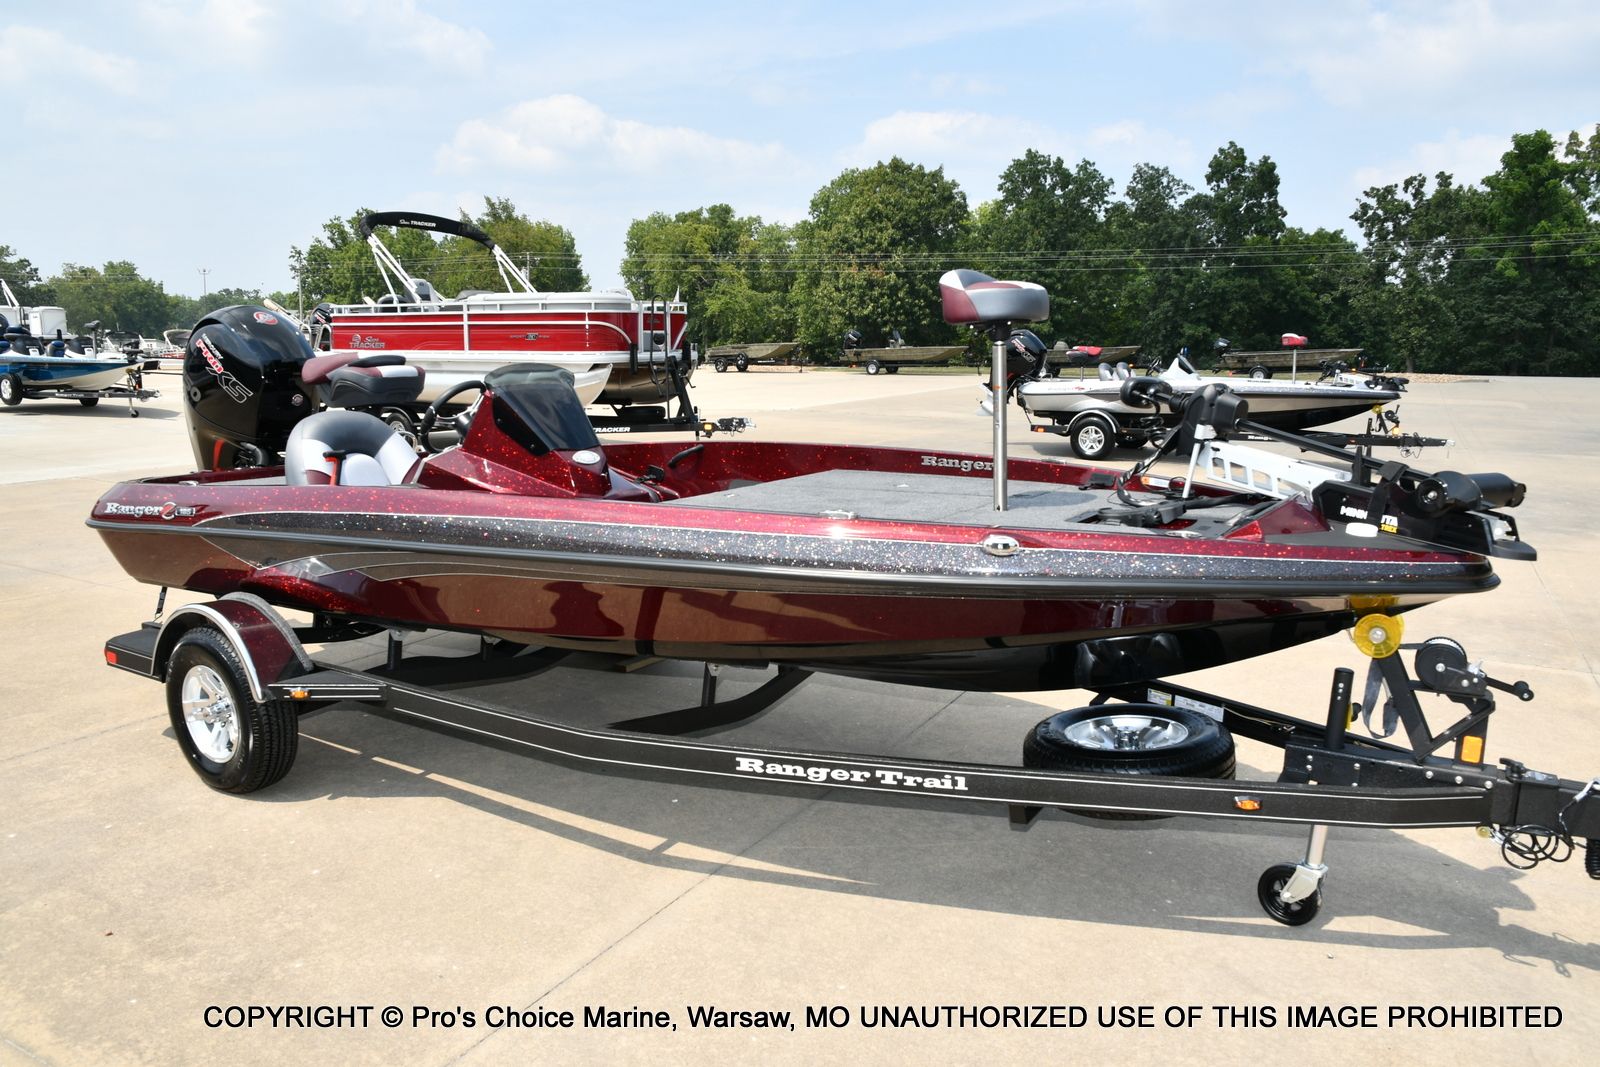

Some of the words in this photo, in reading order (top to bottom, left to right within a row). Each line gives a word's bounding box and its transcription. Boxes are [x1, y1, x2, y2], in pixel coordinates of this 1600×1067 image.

[410, 220, 437, 228] TRACKER
[195, 338, 224, 374] PRO
[205, 366, 254, 404] XS
[921, 455, 994, 472] Ranger
[104, 502, 163, 518] Ranger
[1340, 505, 1369, 520] MINN
[735, 756, 871, 783] Ranger
[875, 769, 969, 791] Trail
